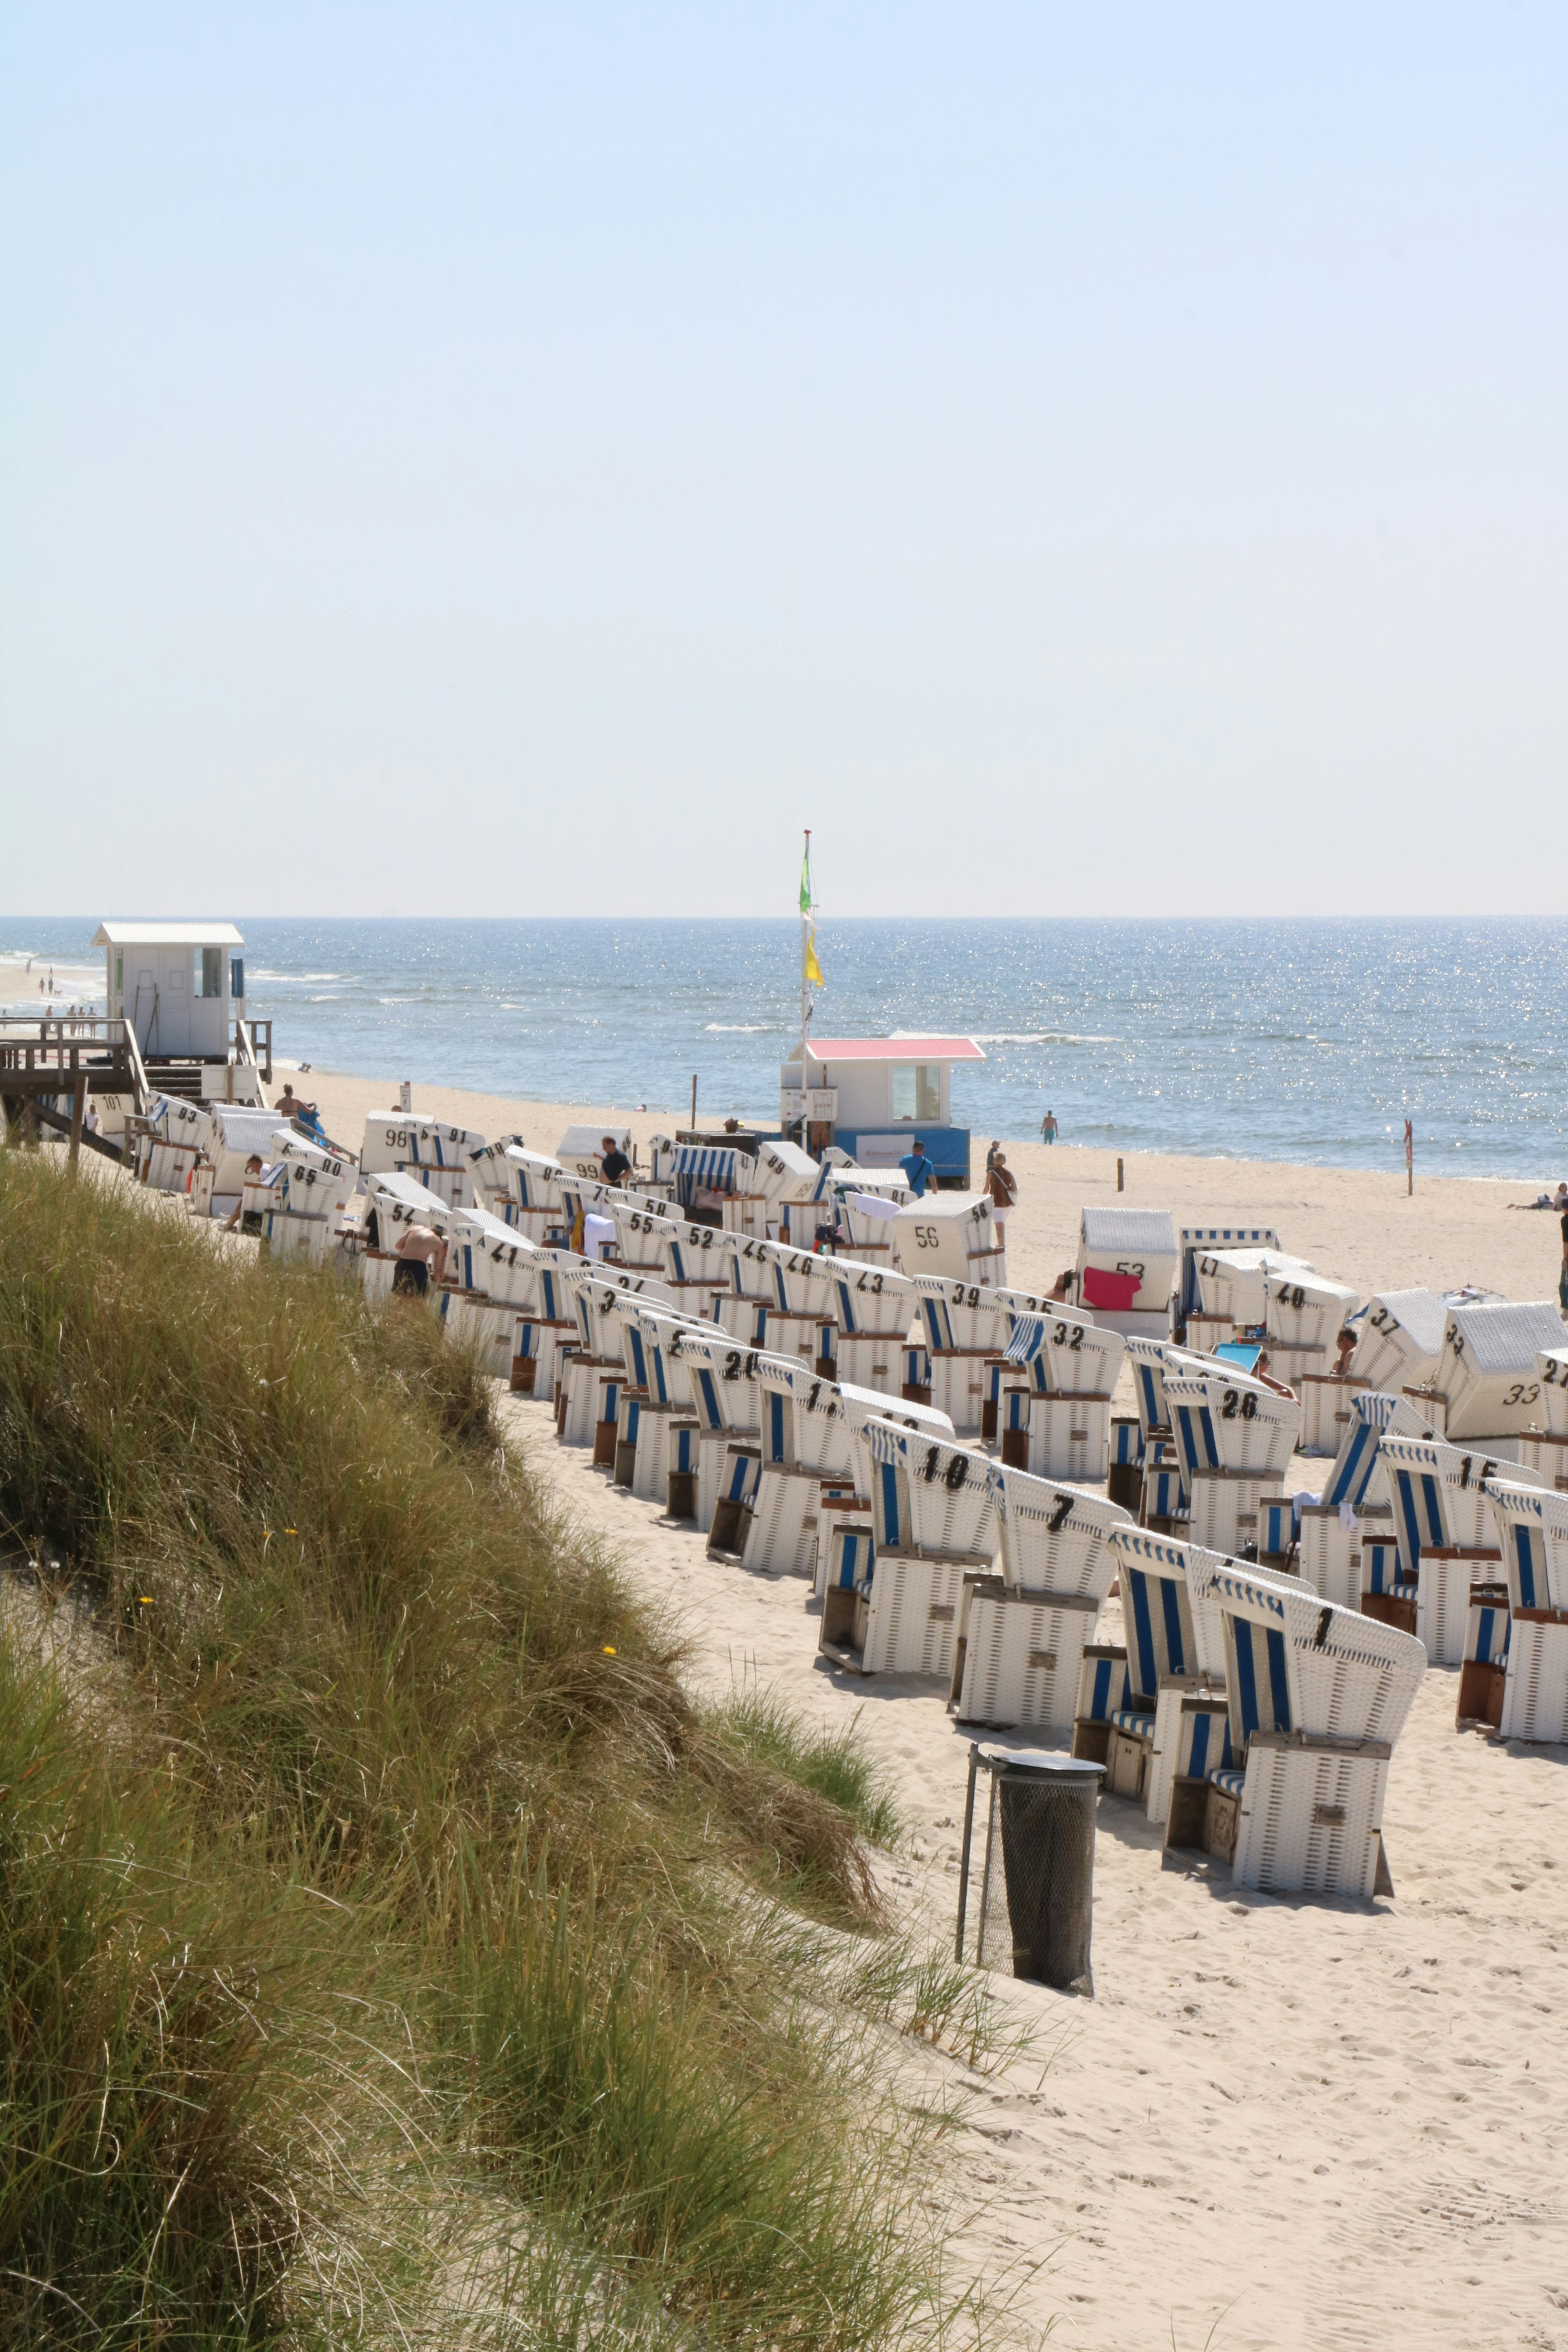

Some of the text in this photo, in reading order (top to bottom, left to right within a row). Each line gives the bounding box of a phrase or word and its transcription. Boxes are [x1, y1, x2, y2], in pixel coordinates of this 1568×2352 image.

[103, 1096, 122, 1110] 101
[386, 1129, 407, 1148] 98
[448, 1129, 466, 1145] 91
[294, 1165, 318, 1186] 65
[577, 1163, 599, 1179] 99
[392, 1204, 416, 1226] 54
[630, 1213, 654, 1235] 55
[689, 1227, 714, 1249] 52
[915, 1226, 939, 1248] 56
[491, 1243, 518, 1269] 41
[1116, 1262, 1145, 1281] 53
[857, 1271, 884, 1296] 43
[952, 1283, 980, 1308] 39
[1370, 1308, 1400, 1336] 37
[1053, 1322, 1084, 1351] 32
[1222, 1389, 1258, 1420] 26
[1503, 1384, 1541, 1405] 33
[924, 1446, 969, 1490] 10
[1047, 1494, 1074, 1532] 7
[1315, 1607, 1333, 1647] 1
